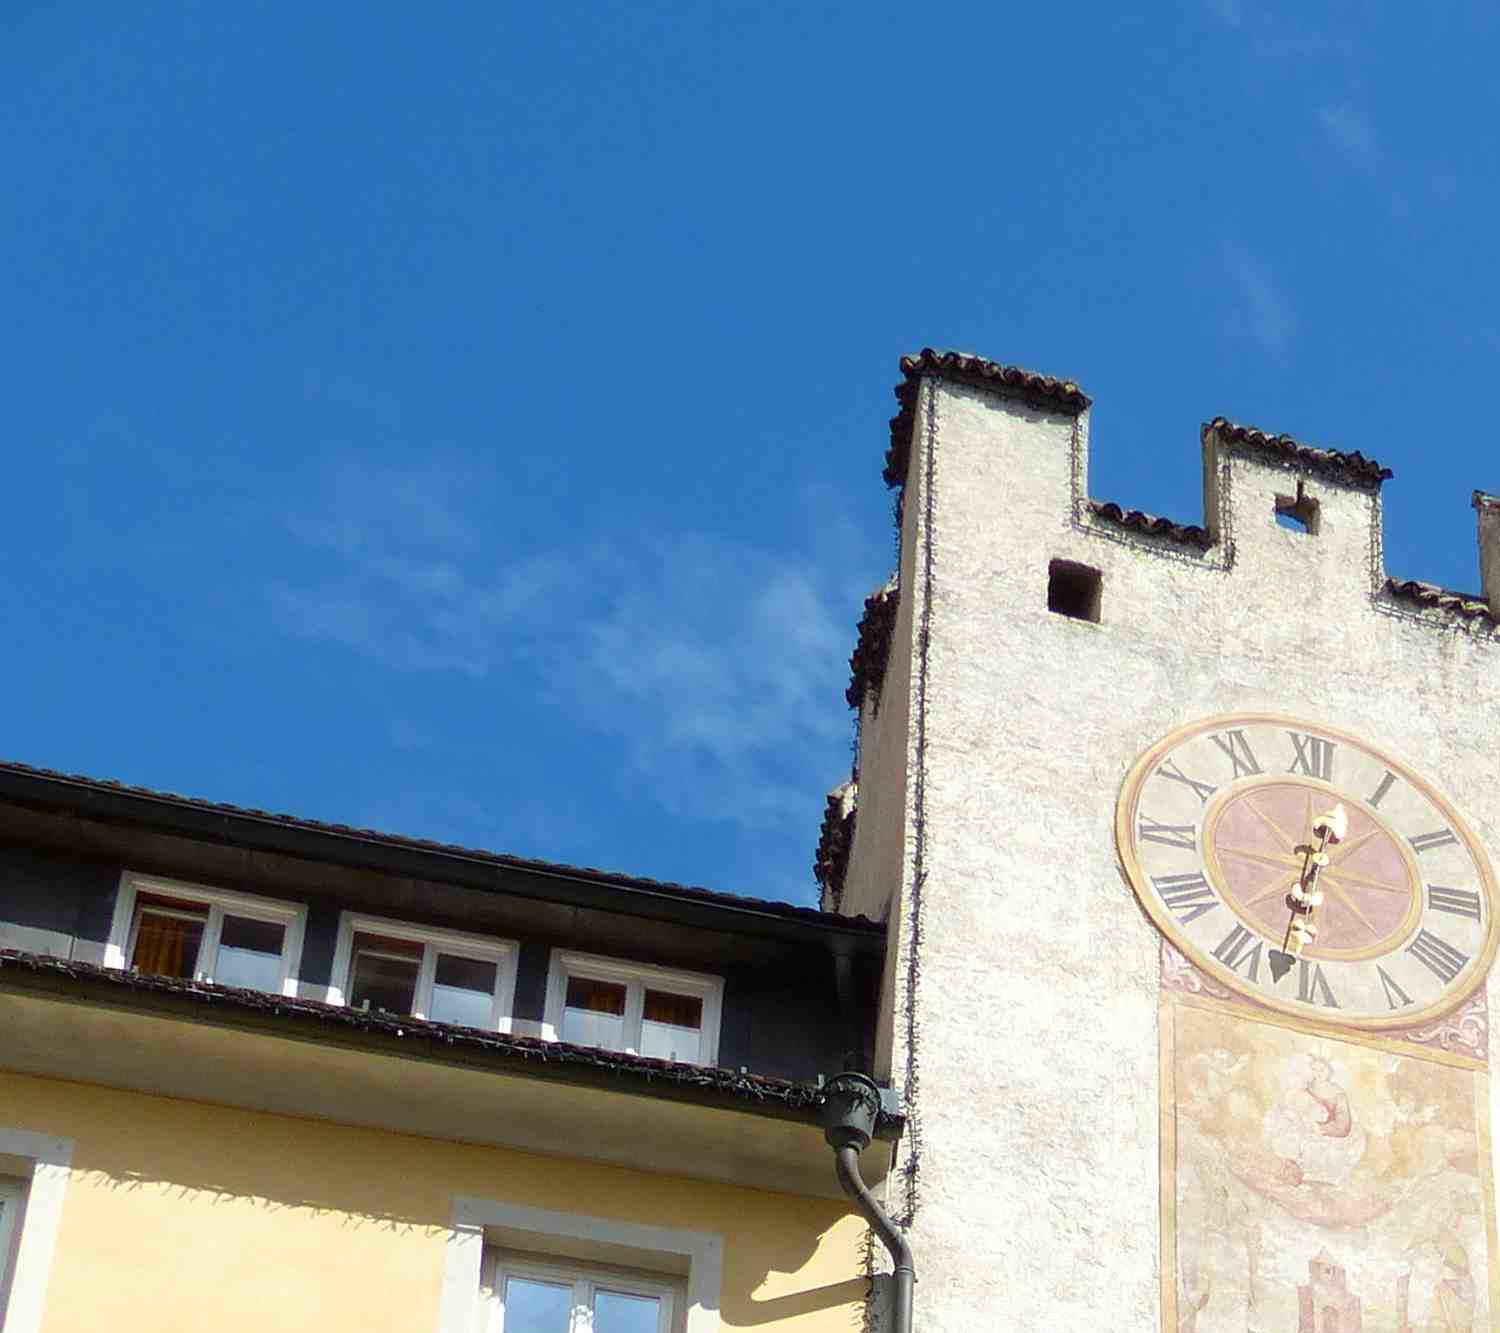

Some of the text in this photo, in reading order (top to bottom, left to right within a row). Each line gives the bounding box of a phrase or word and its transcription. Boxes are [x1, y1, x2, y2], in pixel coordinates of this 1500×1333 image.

[1209, 729, 1264, 778] XI
[1287, 731, 1337, 781] XII
[1156, 759, 1218, 803] X
[1366, 770, 1399, 808] I
[1139, 816, 1196, 851] IX
[1408, 828, 1461, 855] II
[1428, 884, 1482, 921] III
[1297, 959, 1341, 1009] VI
[1376, 964, 1414, 1010] V
